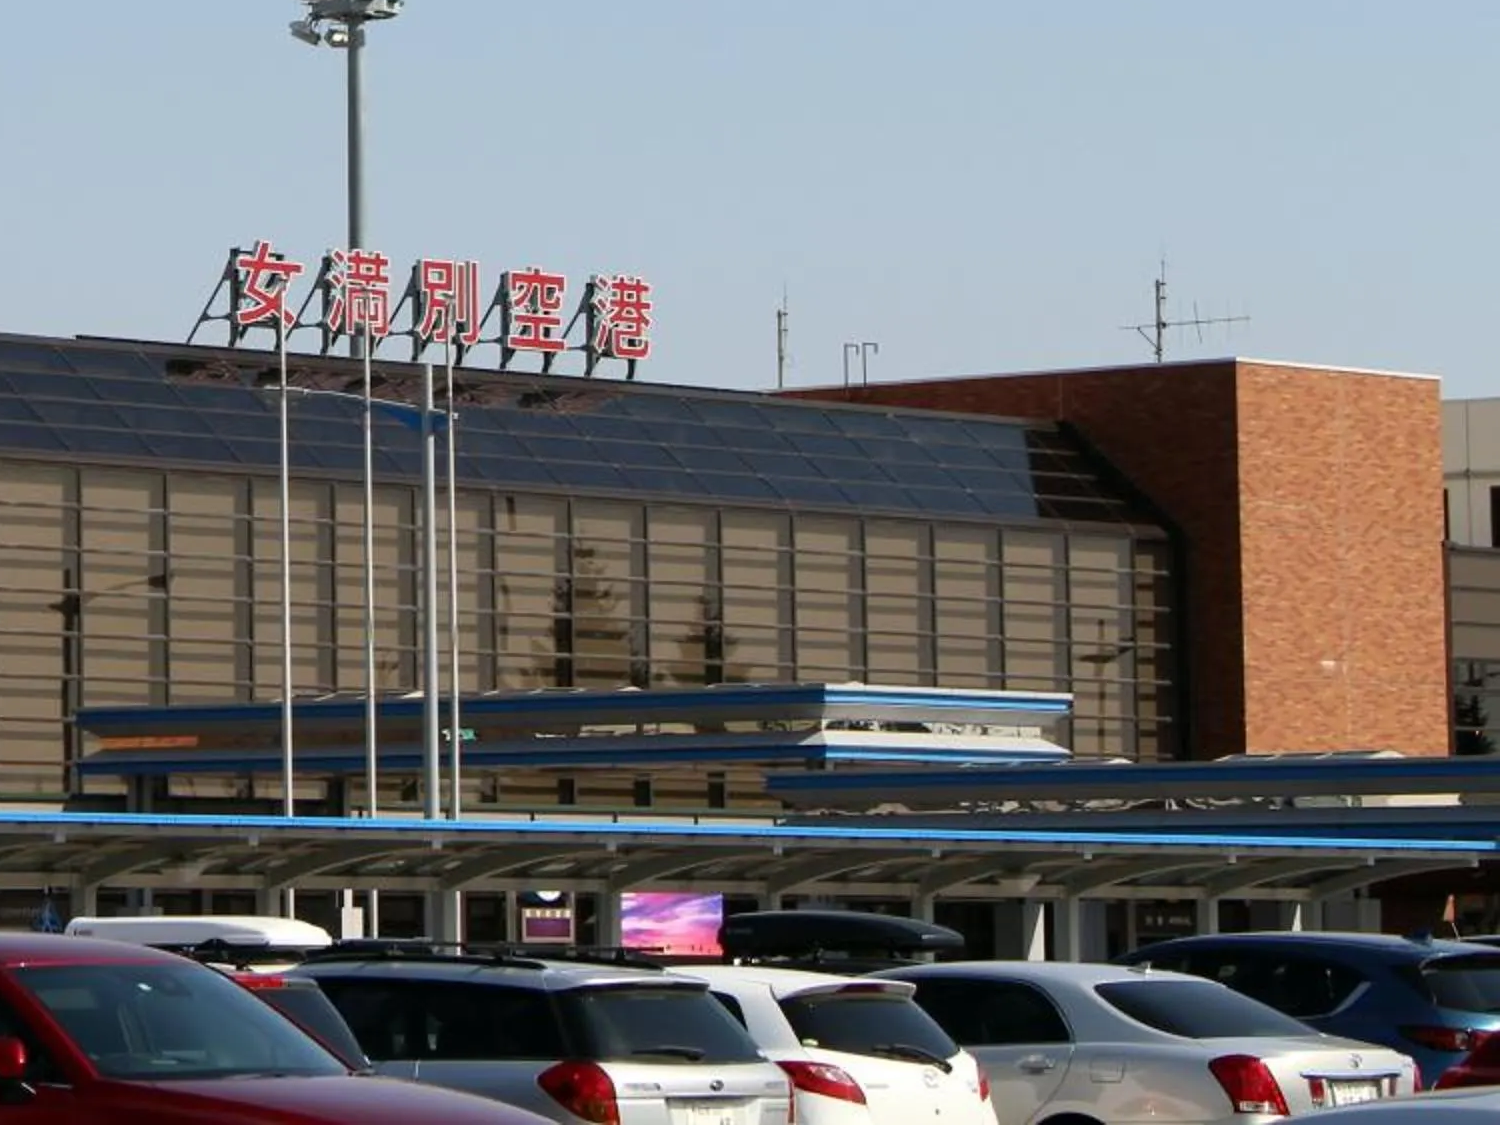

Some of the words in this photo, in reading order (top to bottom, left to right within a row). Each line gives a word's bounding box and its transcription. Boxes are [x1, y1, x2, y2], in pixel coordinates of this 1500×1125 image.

[236, 240, 652, 359] 女満別空港
